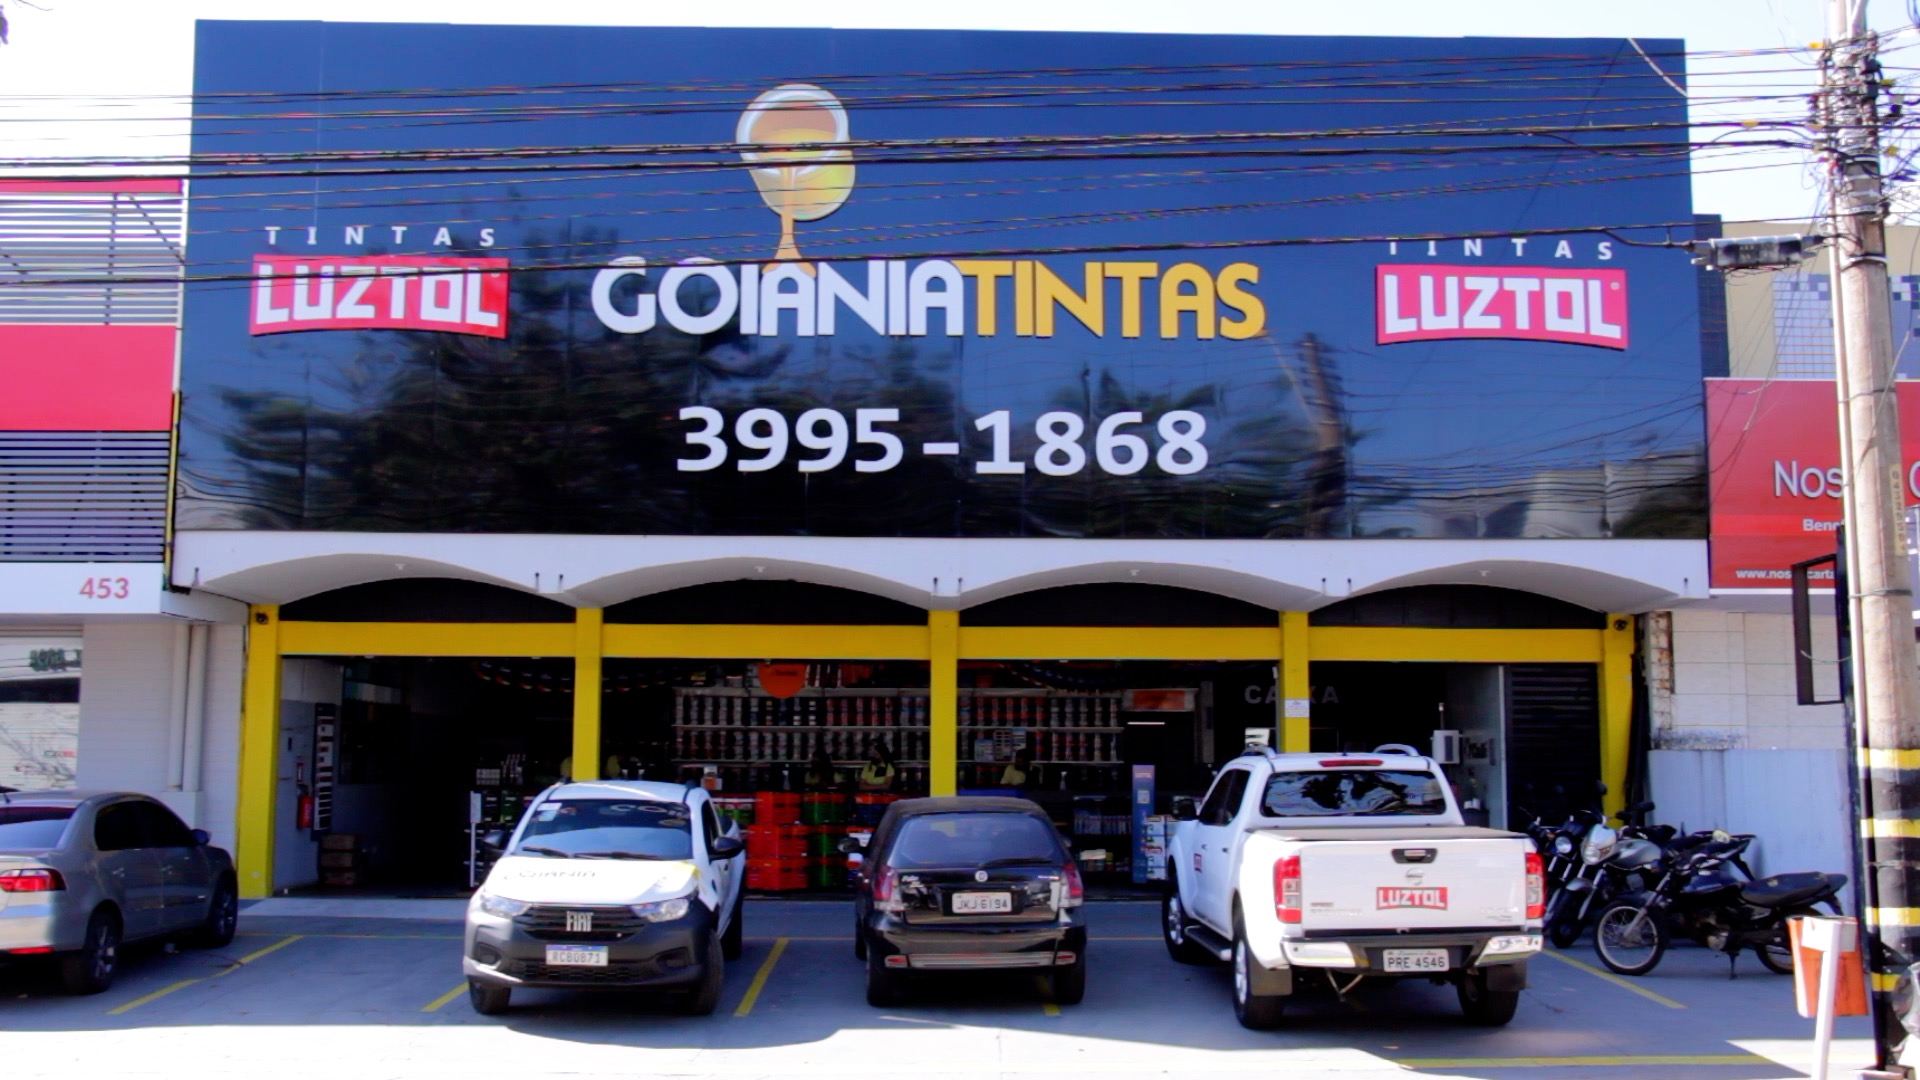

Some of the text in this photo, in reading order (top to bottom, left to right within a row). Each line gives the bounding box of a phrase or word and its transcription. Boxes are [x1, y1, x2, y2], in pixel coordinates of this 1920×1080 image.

[265, 226, 495, 247] TINTAS
[255, 263, 500, 328] LUZTOL
[1383, 273, 1622, 339] LUZTOL
[1773, 460, 1844, 498] Nos
[79, 577, 130, 600] 453
[1244, 685, 1340, 704] CAA
[1379, 888, 1446, 908] LUZTOL
[566, 911, 593, 931] FIAT
